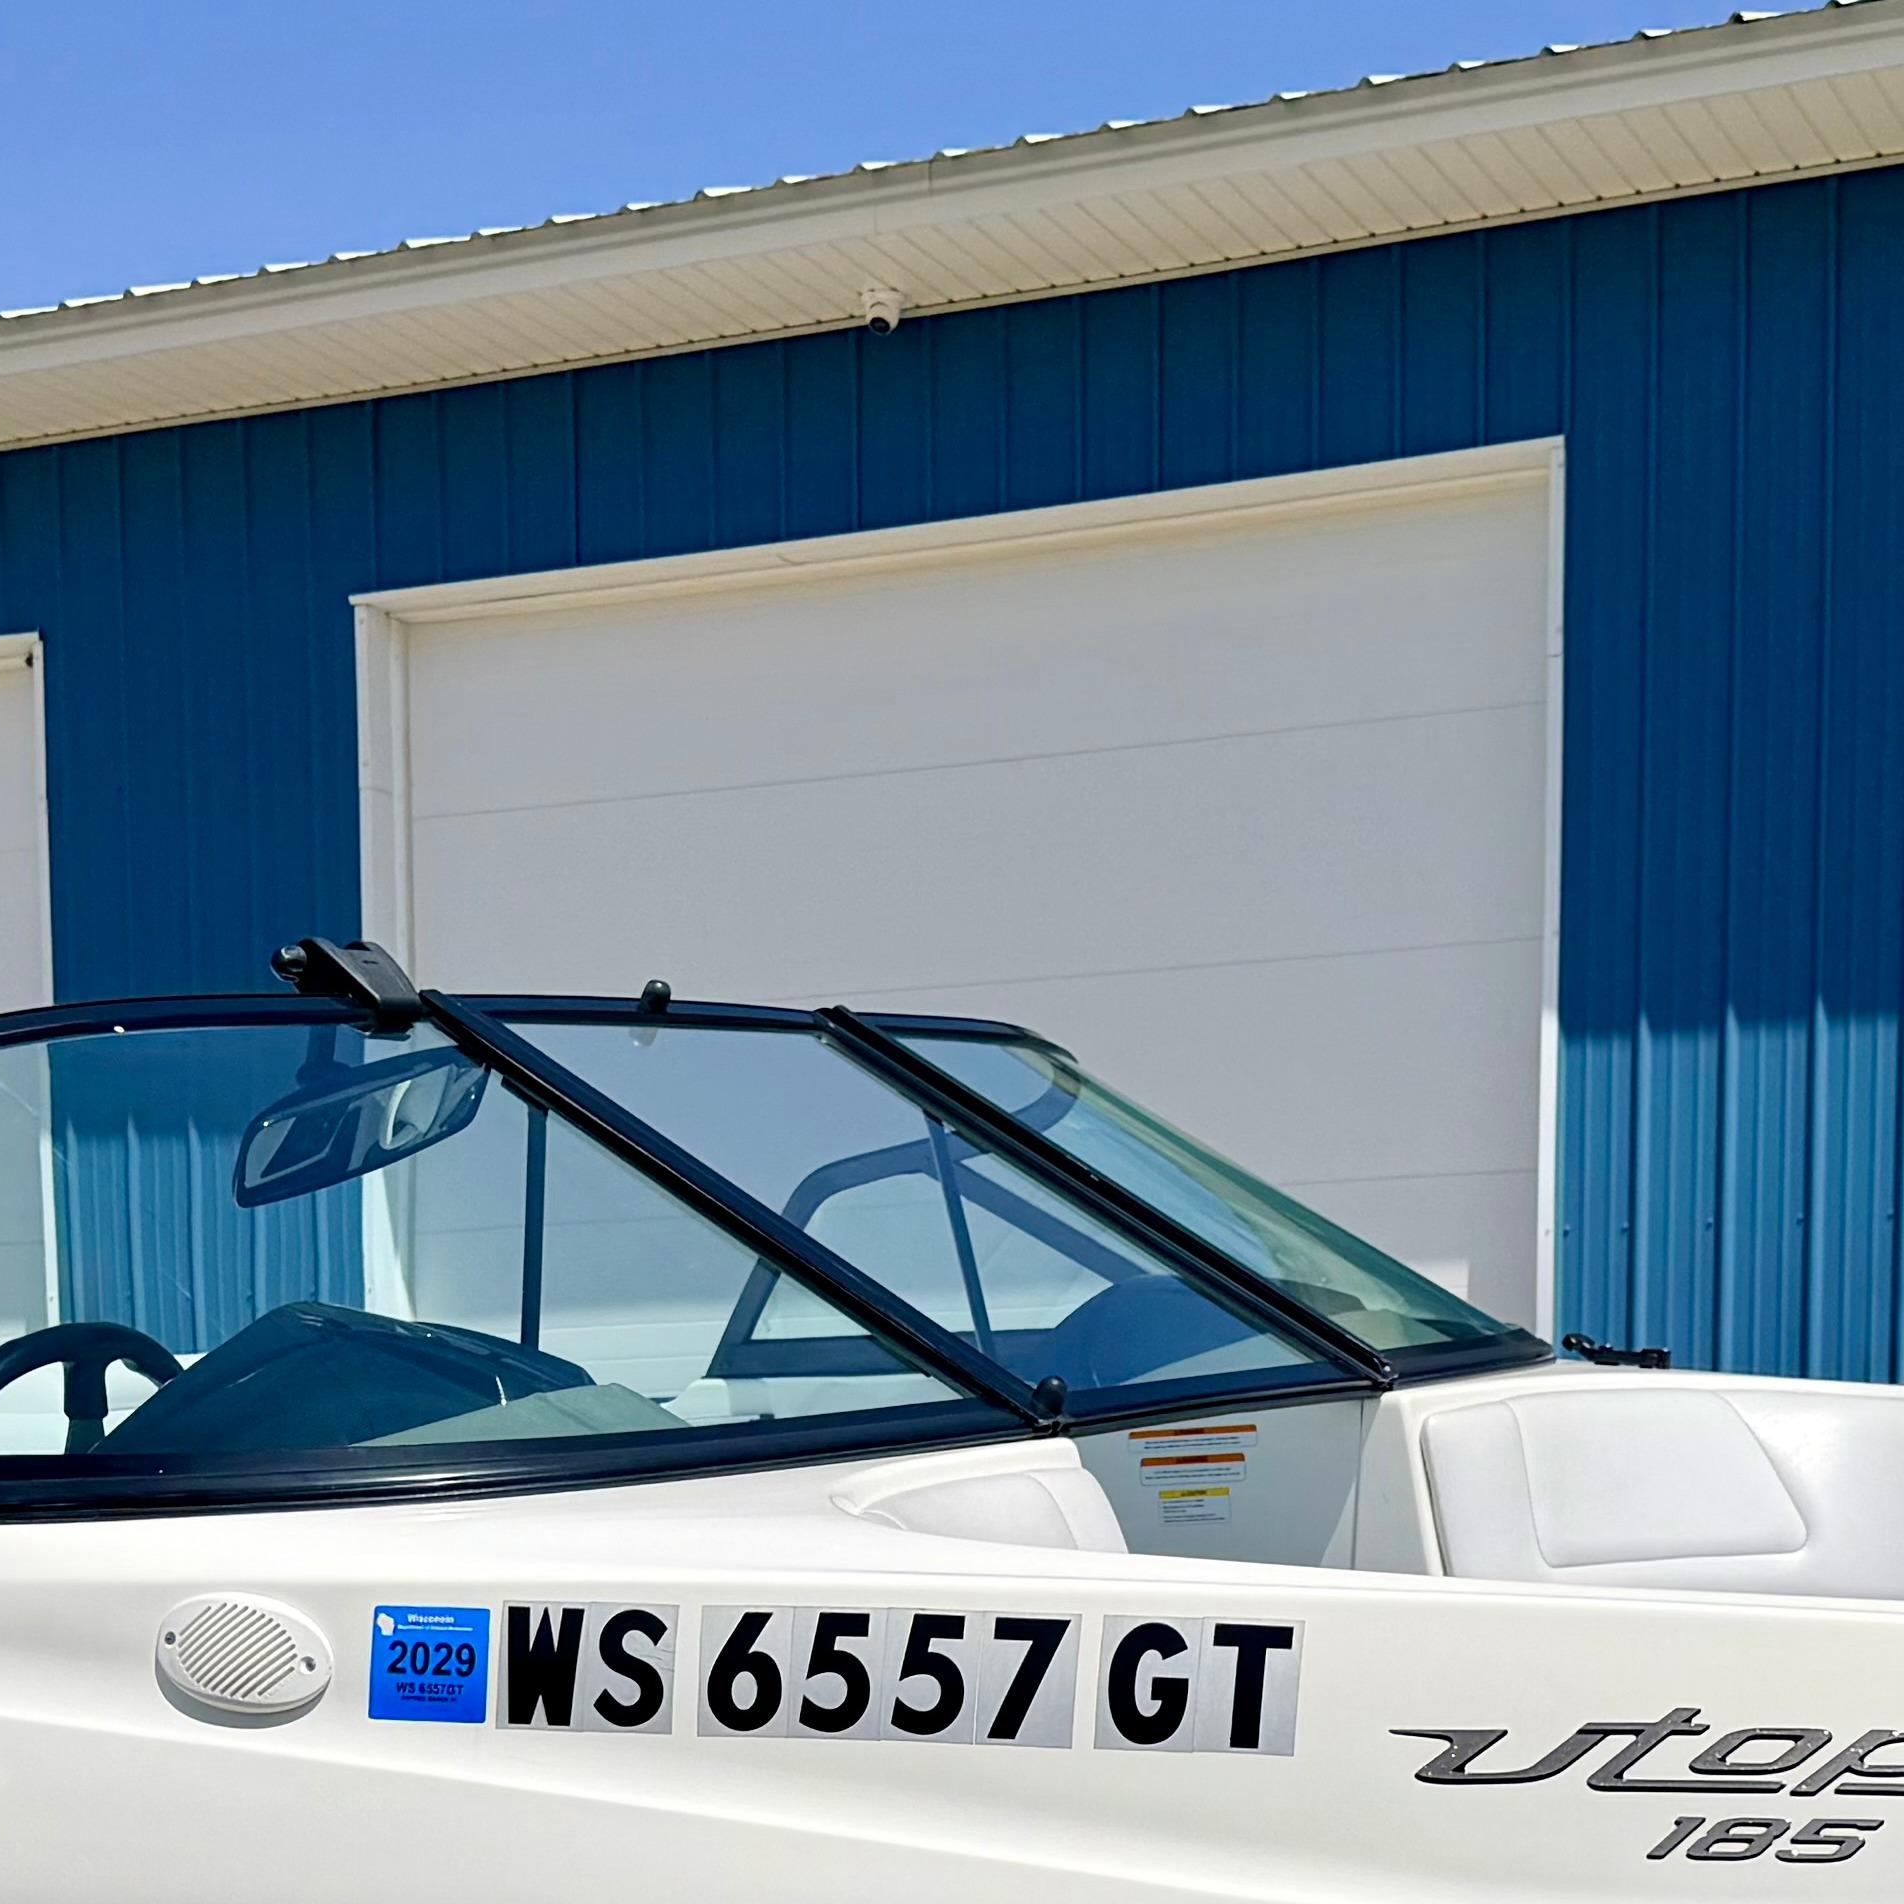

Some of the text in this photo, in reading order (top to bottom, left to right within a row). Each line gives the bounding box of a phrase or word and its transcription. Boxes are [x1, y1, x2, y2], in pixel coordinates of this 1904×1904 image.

[387, 1640, 476, 1677] 2029
[506, 1606, 1294, 1748] WS 6557 GT
[396, 1681, 415, 1693] WS
[1645, 1815, 1885, 1863] 185
